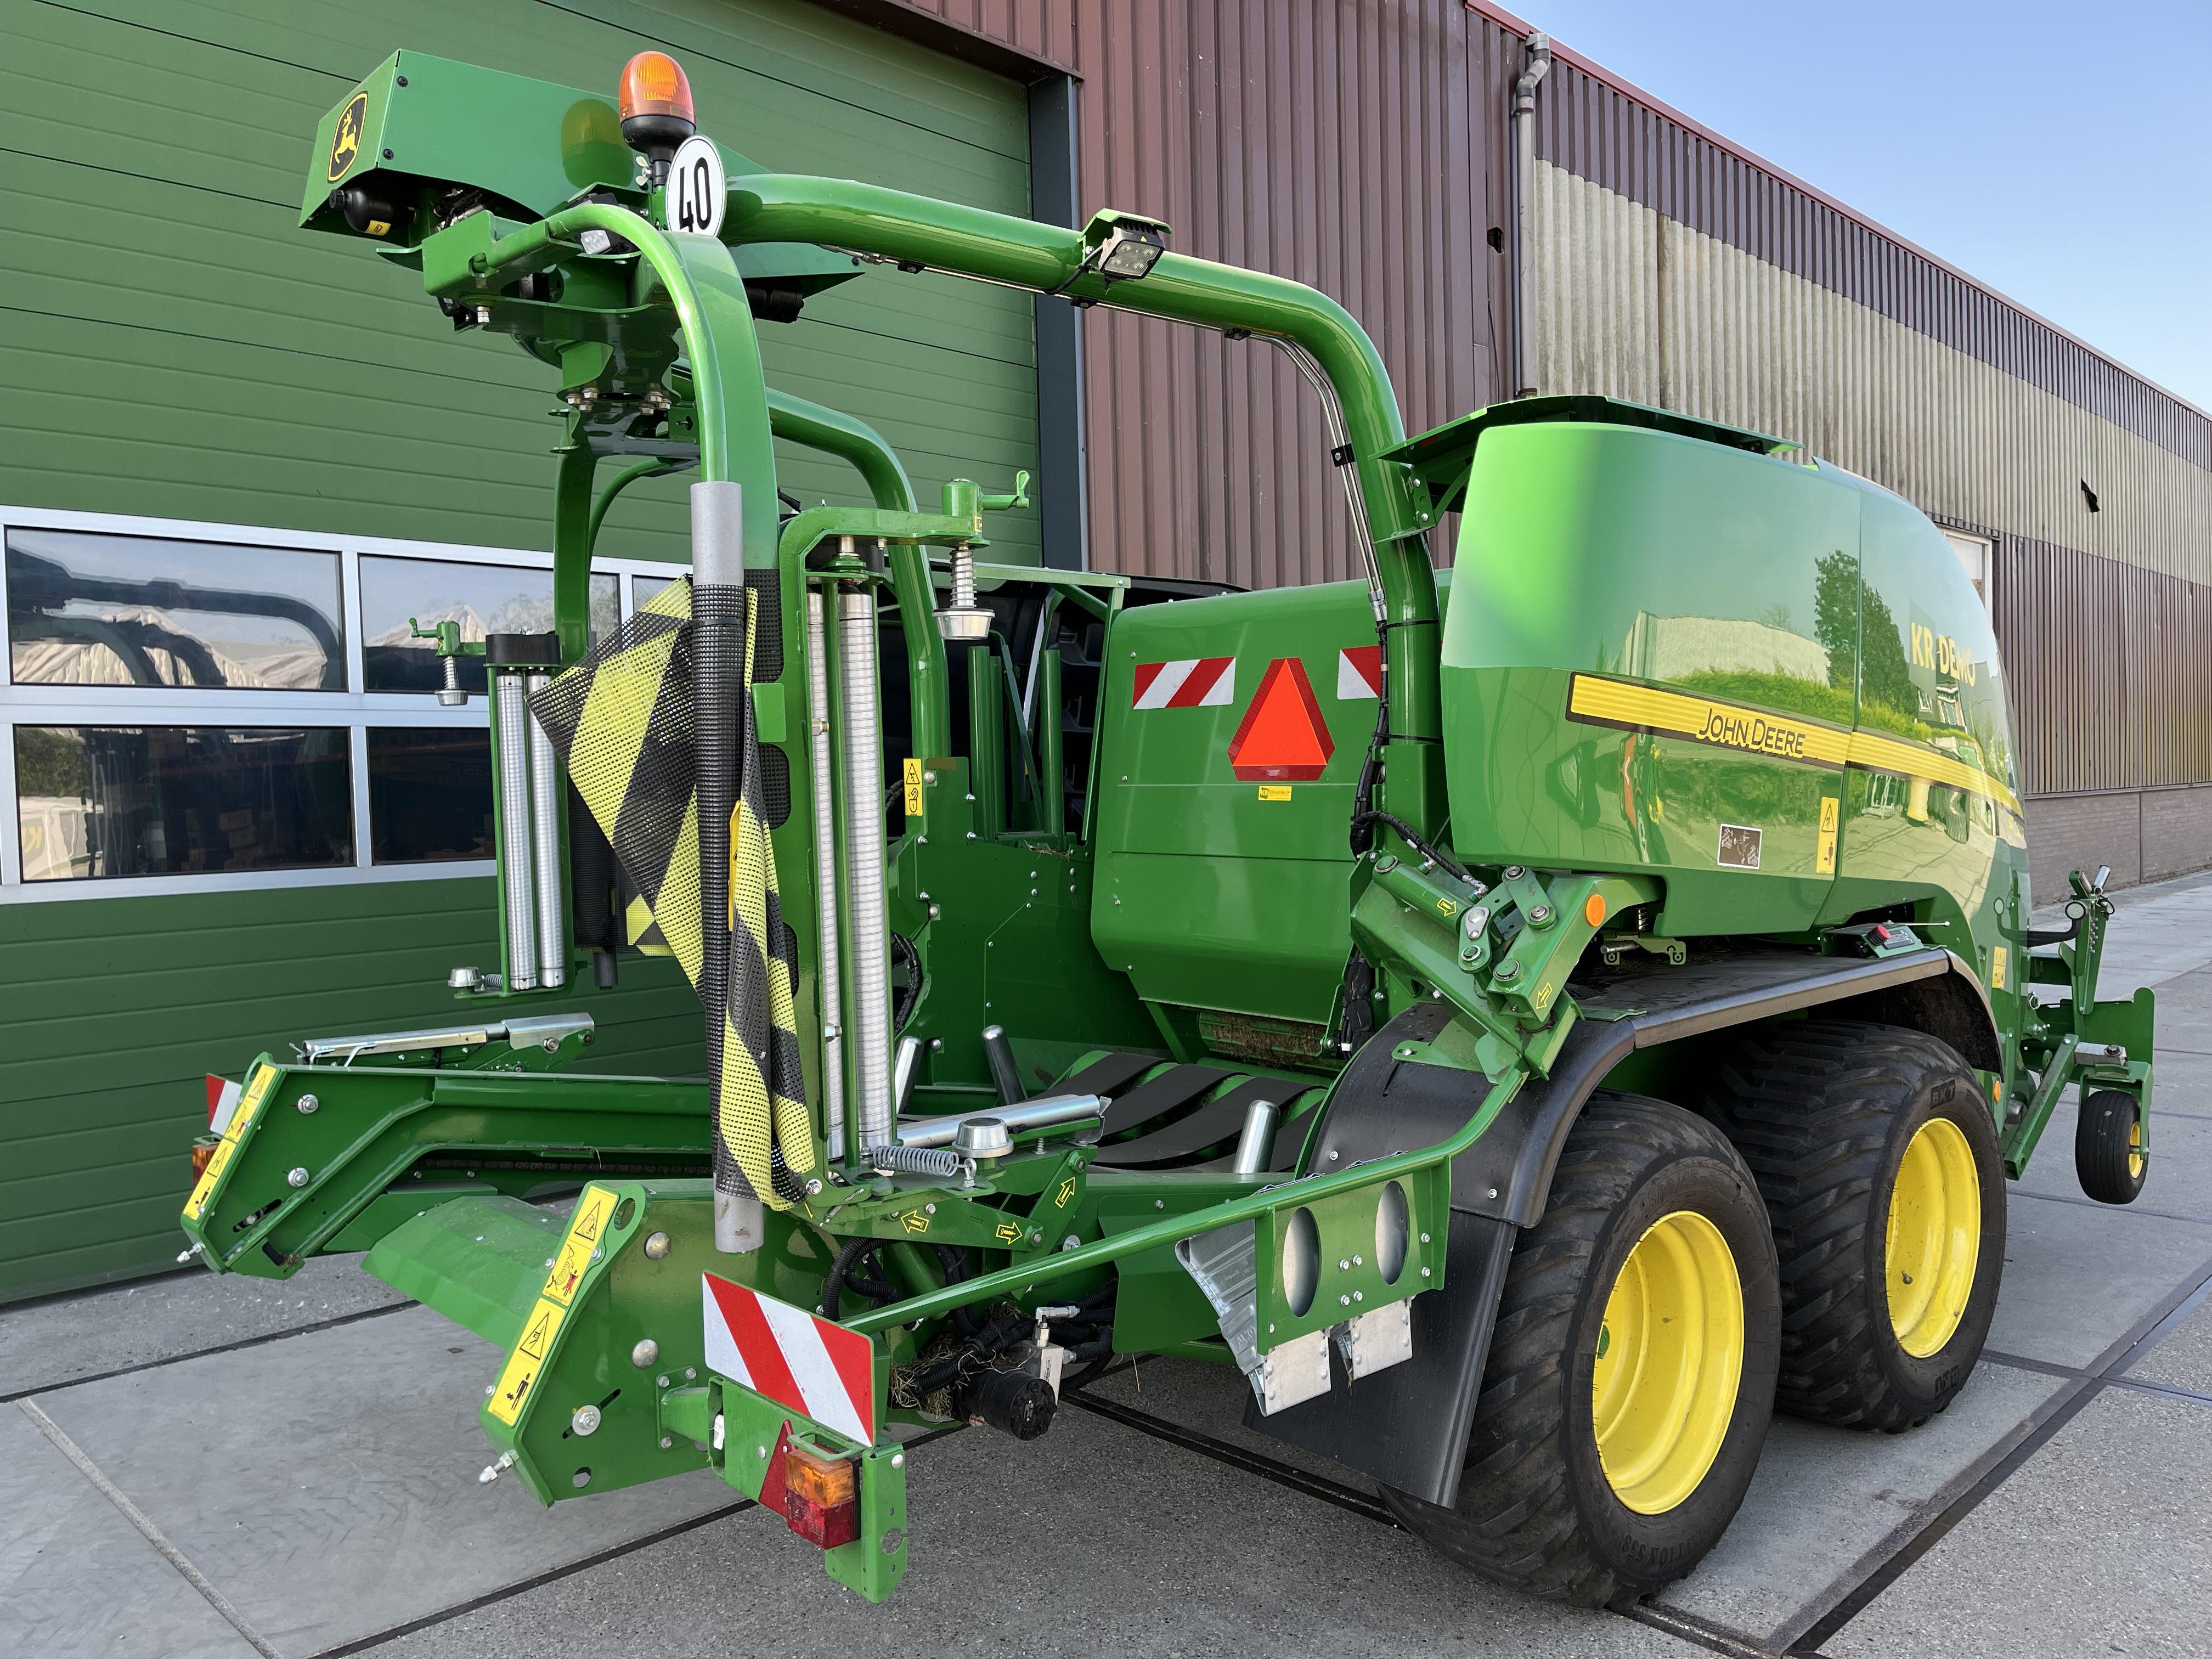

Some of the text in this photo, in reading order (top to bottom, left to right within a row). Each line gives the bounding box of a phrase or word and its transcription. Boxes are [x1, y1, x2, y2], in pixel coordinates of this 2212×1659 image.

[679, 157, 712, 233] 40
[1910, 622, 1976, 687] KR DEMO
[1699, 708, 1806, 754] JOHN DEERE
[1931, 1080, 1955, 1109] BKT
